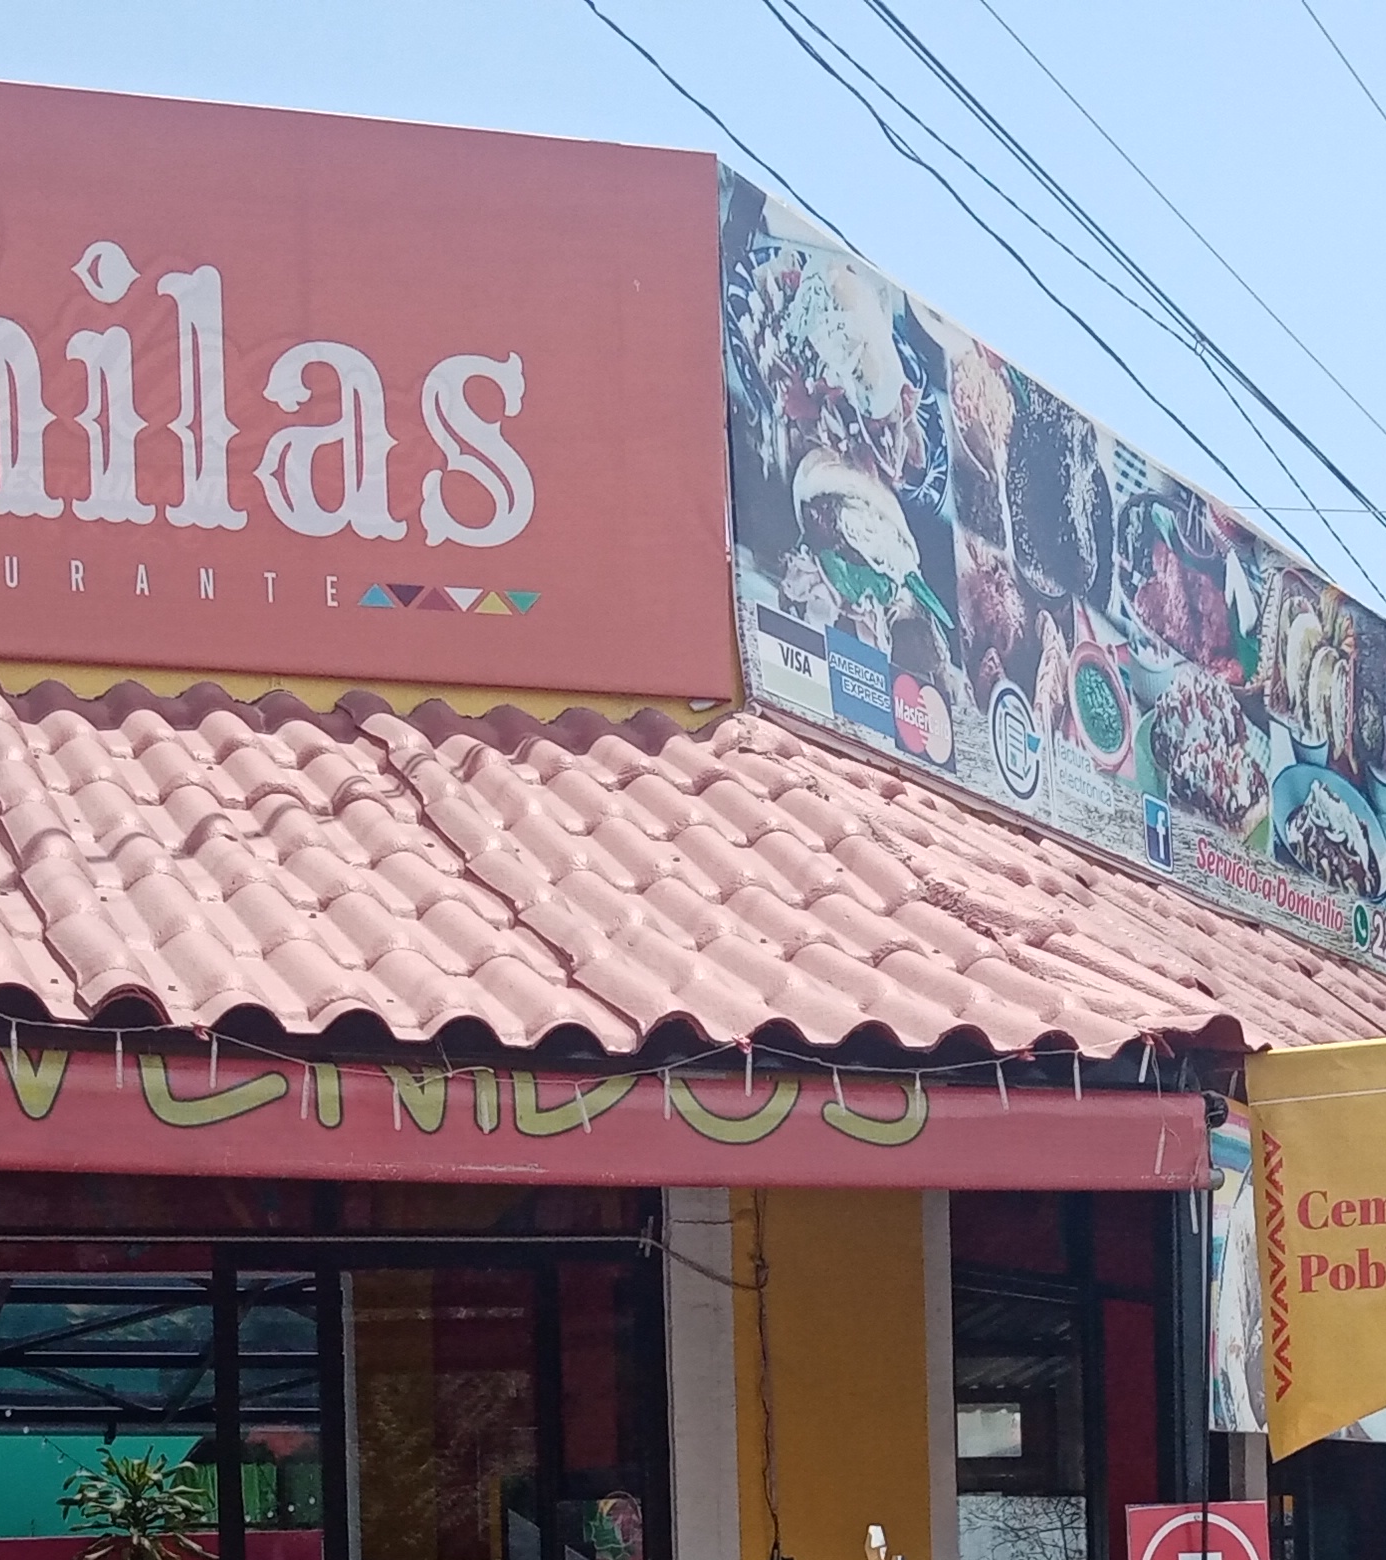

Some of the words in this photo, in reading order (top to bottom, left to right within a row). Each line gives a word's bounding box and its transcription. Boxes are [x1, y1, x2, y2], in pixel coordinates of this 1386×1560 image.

[778, 642, 814, 680] VISA
[828, 650, 888, 690] AMERICAN
[841, 674, 891, 710] EXPRESS
[893, 697, 951, 744] MasterCard
[1196, 836, 1260, 893] Servicio
[1275, 874, 1345, 934] Domicilio
